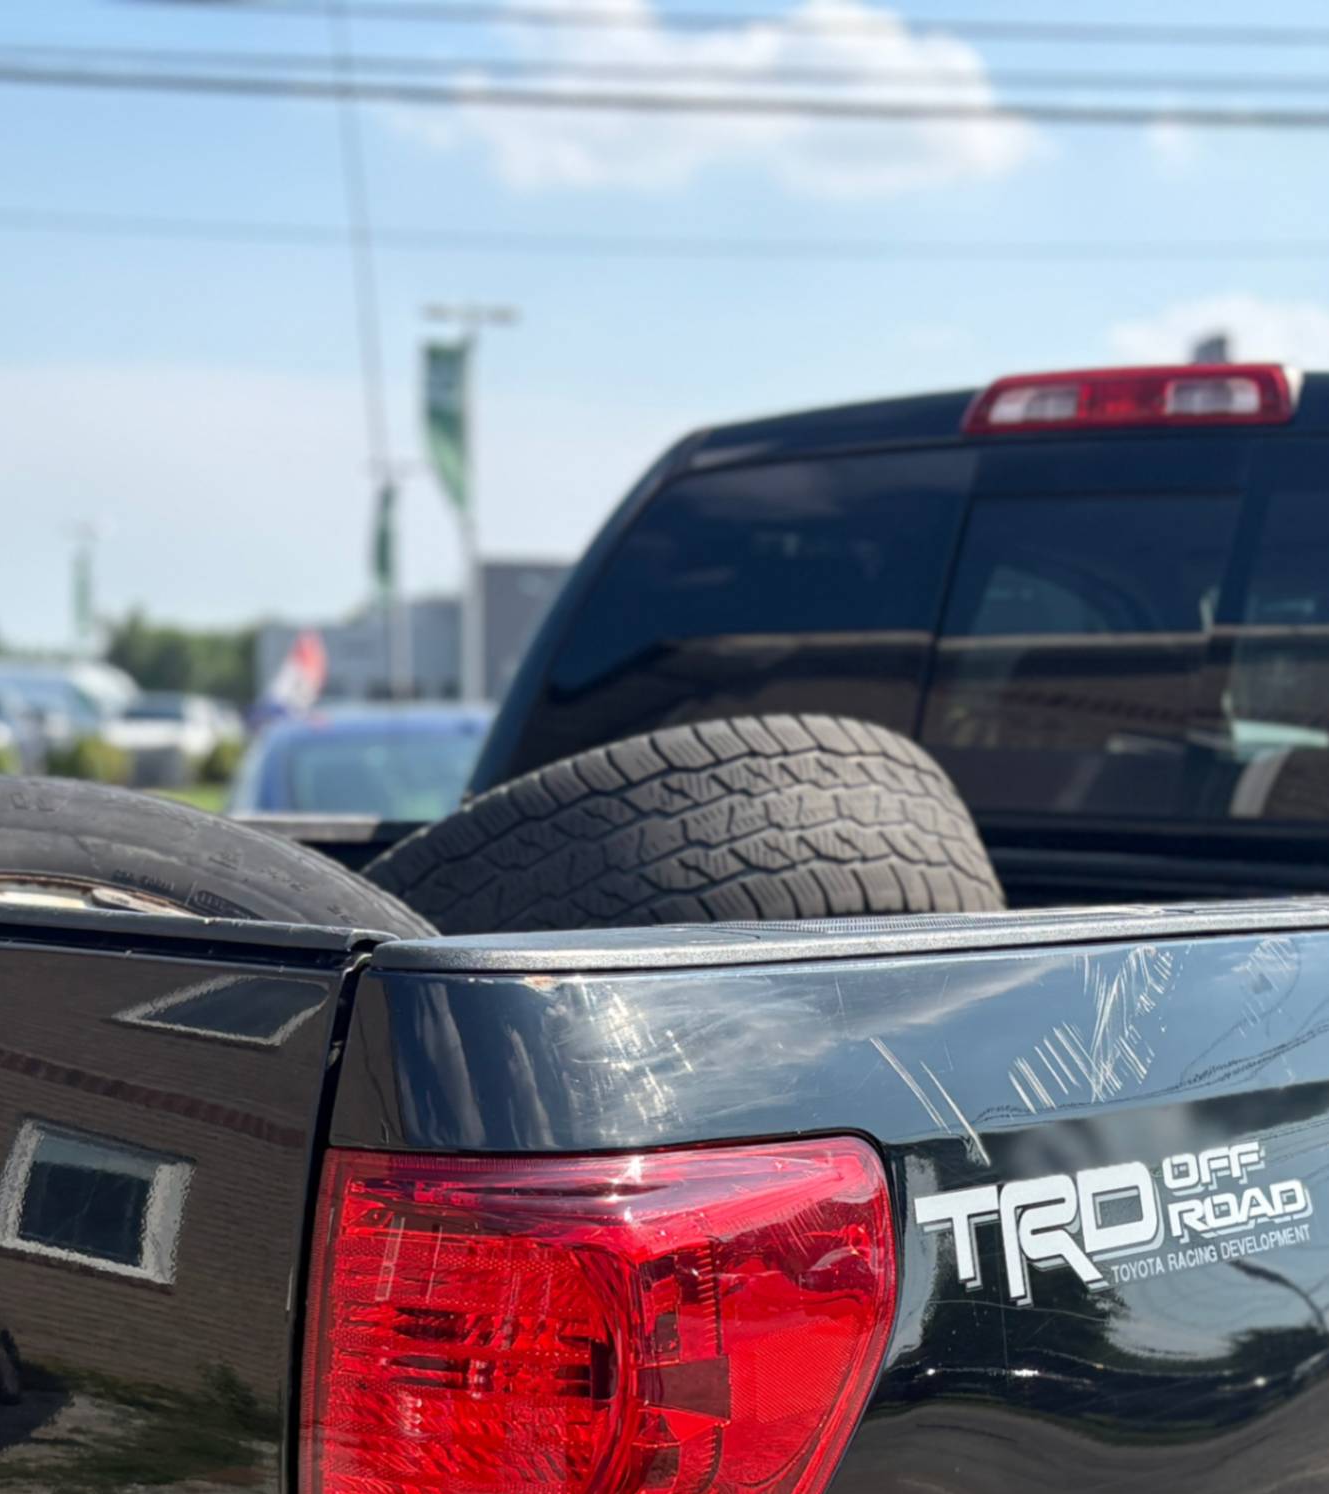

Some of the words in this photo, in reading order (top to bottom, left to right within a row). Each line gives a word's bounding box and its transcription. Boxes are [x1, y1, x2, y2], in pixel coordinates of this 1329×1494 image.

[1162, 1141, 1266, 1196] OFF
[914, 1160, 1164, 1306] TRD
[1167, 1179, 1314, 1244] ROAD
[1111, 1257, 1165, 1284] TOYOTA
[1167, 1245, 1219, 1271] RACING
[1221, 1223, 1311, 1260] DEVELOPMENT
